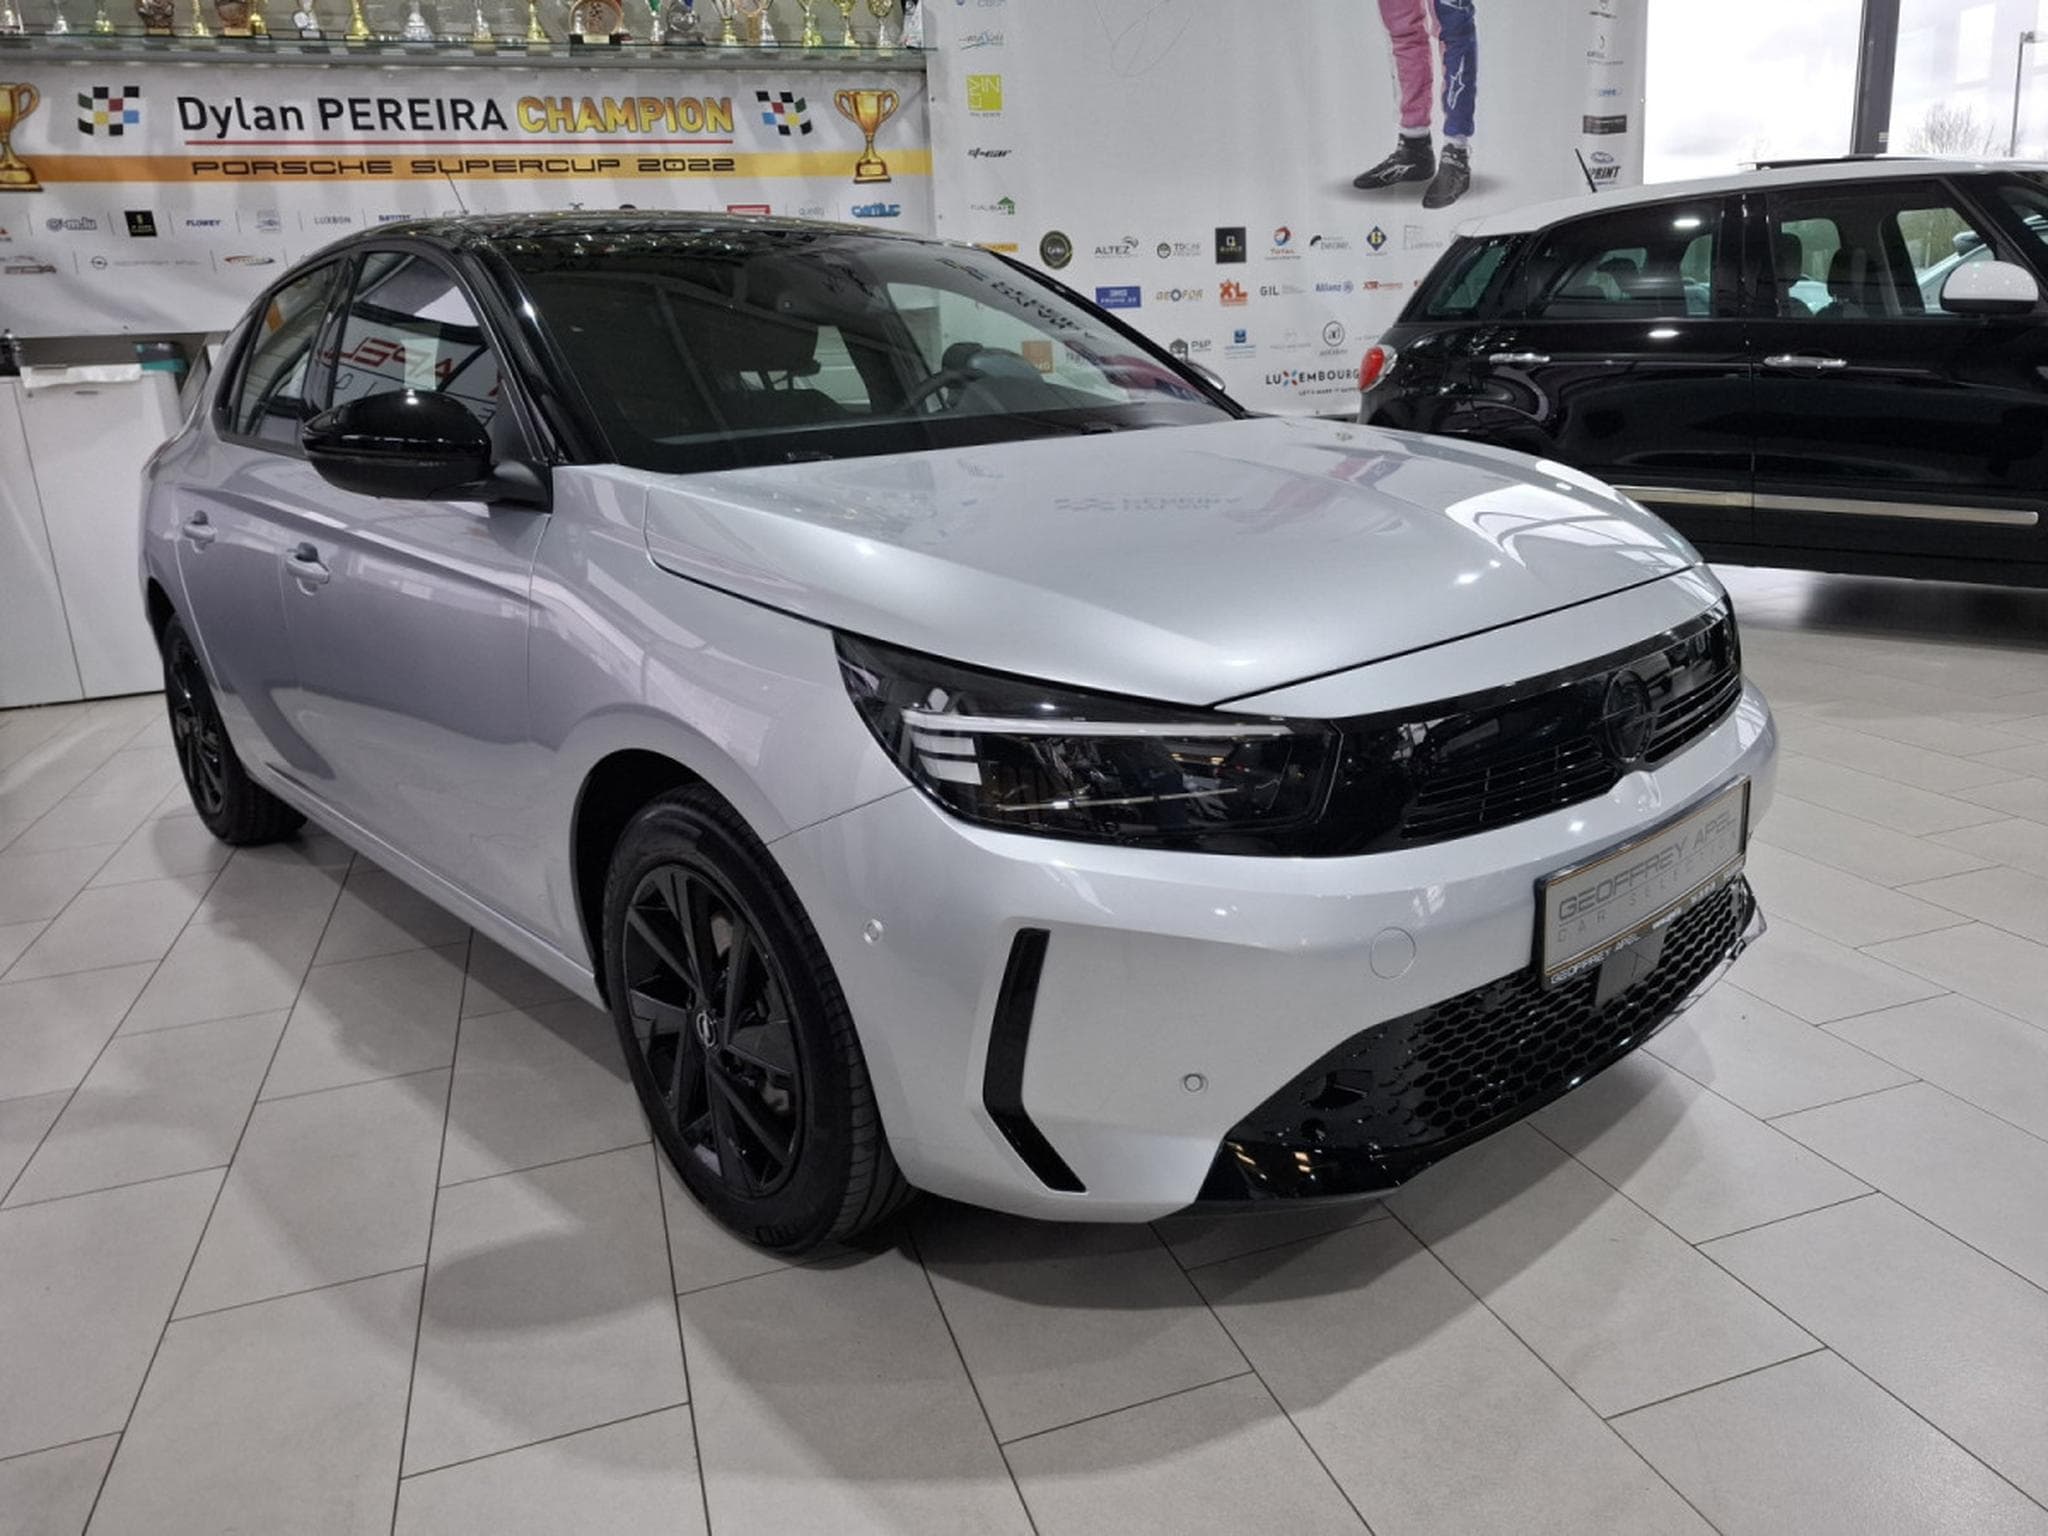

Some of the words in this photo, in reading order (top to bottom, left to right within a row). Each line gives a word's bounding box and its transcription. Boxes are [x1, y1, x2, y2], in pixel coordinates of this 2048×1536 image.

[177, 96, 304, 139] Dylan
[318, 97, 508, 131] PEREIRA
[516, 96, 734, 134] CHAMPION
[192, 160, 393, 175] PORSCHE
[411, 158, 620, 175] SUPERCUP
[638, 158, 735, 172] 2022
[1260, 286, 1279, 296] GIL
[1558, 837, 1688, 921] GEOFFREY
[1694, 813, 1736, 849] APEL
